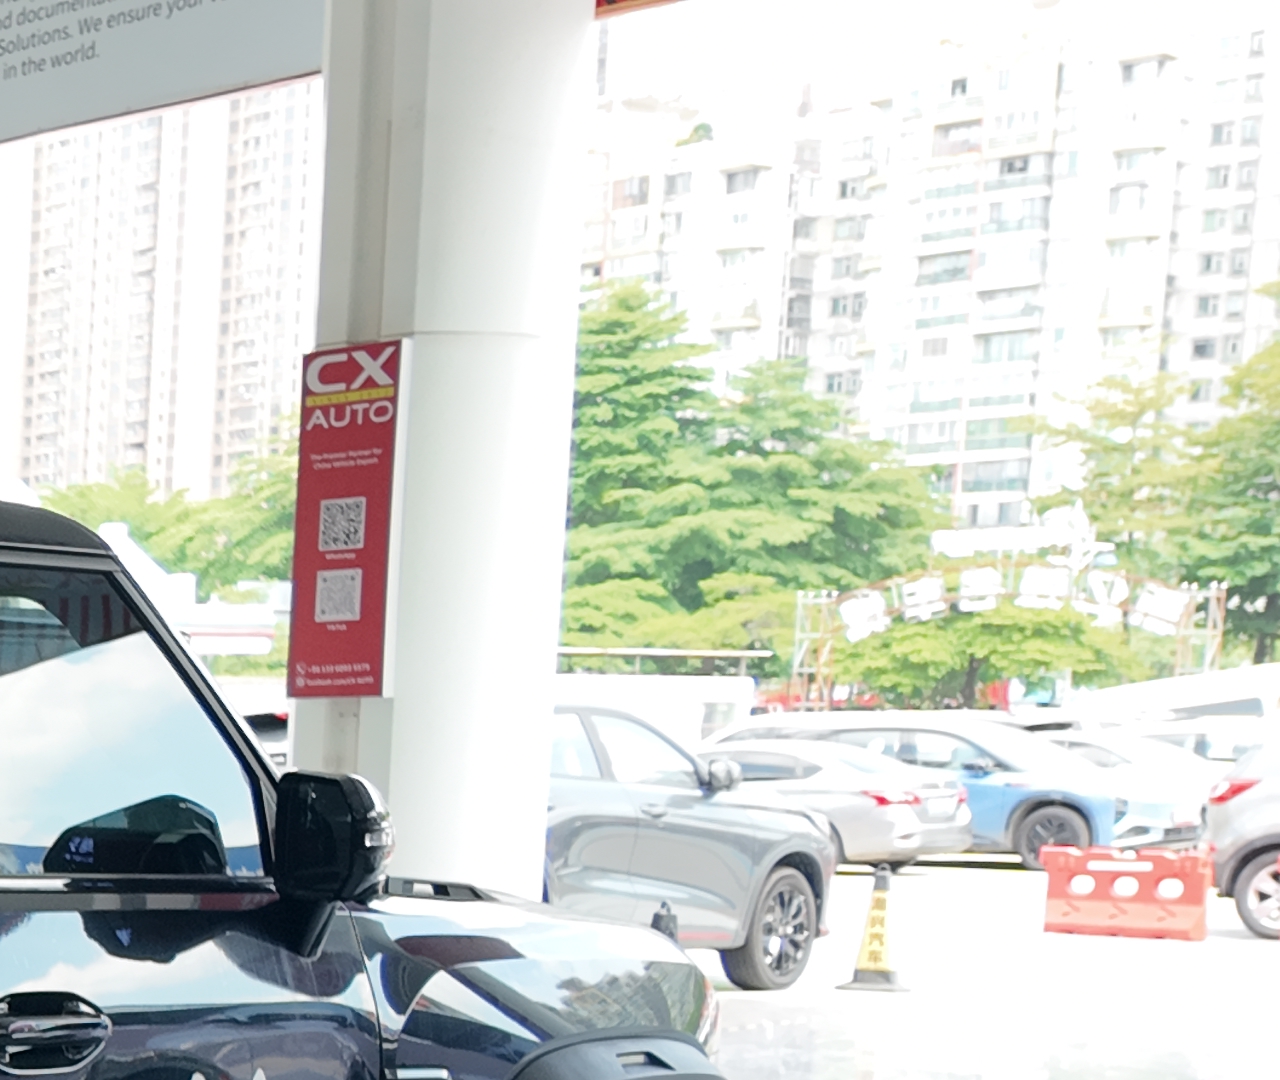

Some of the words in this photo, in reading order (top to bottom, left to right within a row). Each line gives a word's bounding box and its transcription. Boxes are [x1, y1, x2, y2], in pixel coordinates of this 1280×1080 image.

[78, 17, 102, 36] We
[106, 4, 162, 29] ensure
[3, 63, 17, 80] in
[21, 54, 46, 75] the
[50, 41, 100, 69] world.
[306, 346, 396, 394] CX
[306, 400, 393, 431] AUTO
